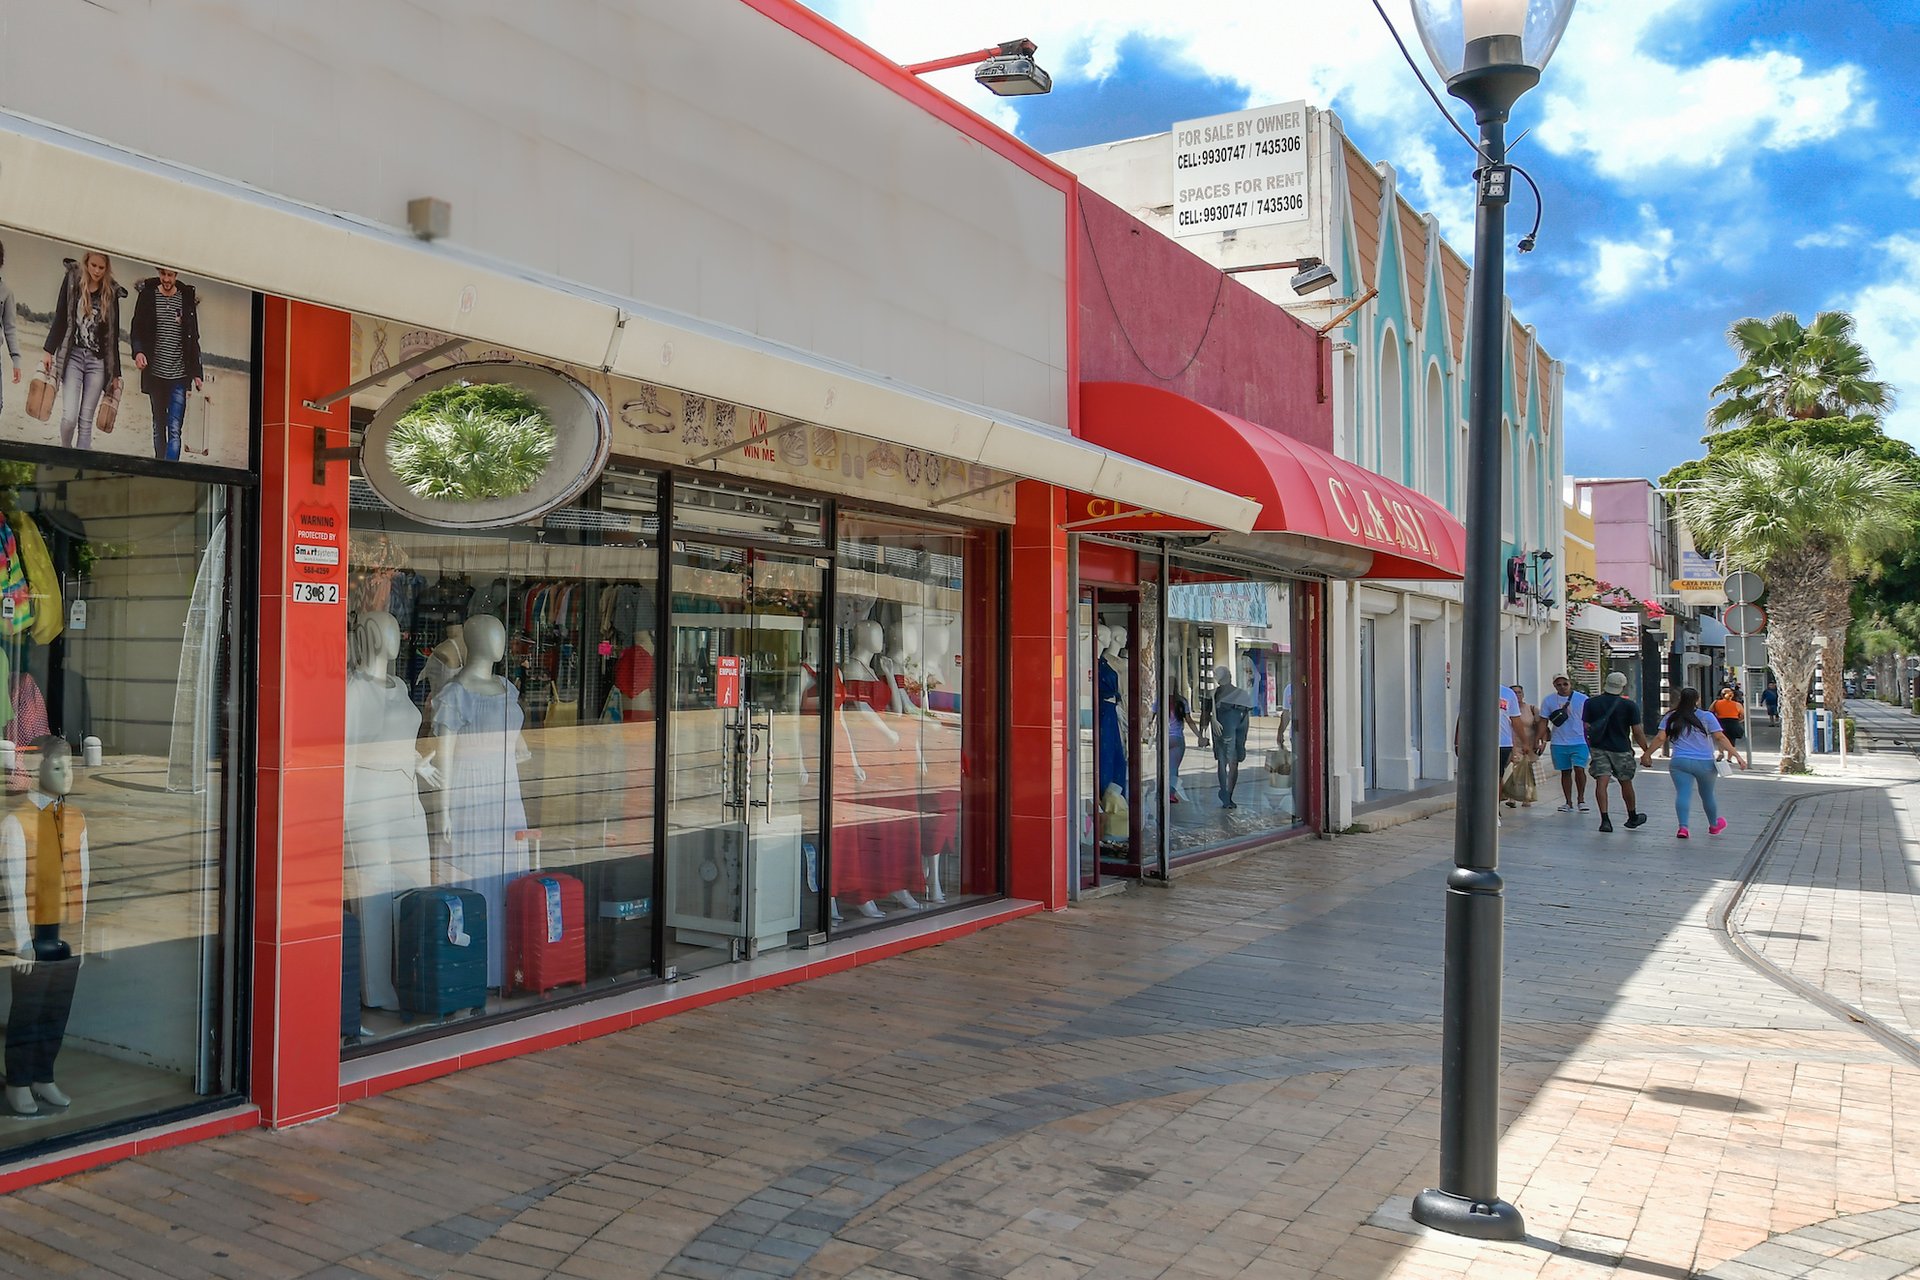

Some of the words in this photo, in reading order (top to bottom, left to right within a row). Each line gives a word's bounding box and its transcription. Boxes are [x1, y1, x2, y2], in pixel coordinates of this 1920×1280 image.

[1178, 131, 1201, 147] FOR
[1204, 123, 1234, 143] SALE
[1237, 120, 1253, 138] BY
[1256, 111, 1300, 134] OWNER
[1255, 135, 1301, 157] 7435306
[1179, 183, 1231, 203] SPACES
[1234, 179, 1262, 195] FOR
[1266, 171, 1304, 191] RENT
[1257, 194, 1303, 215] 7435306
[743, 445, 760, 460] WIN
[762, 447, 776, 462] ME
[300, 514, 334, 527] WARNING
[297, 530, 328, 540] PROTECTED
[328, 532, 336, 541] BY
[295, 583, 336, 602] 7382
[719, 667, 737, 676] EMPUJE
[722, 659, 735, 667] PUSH
